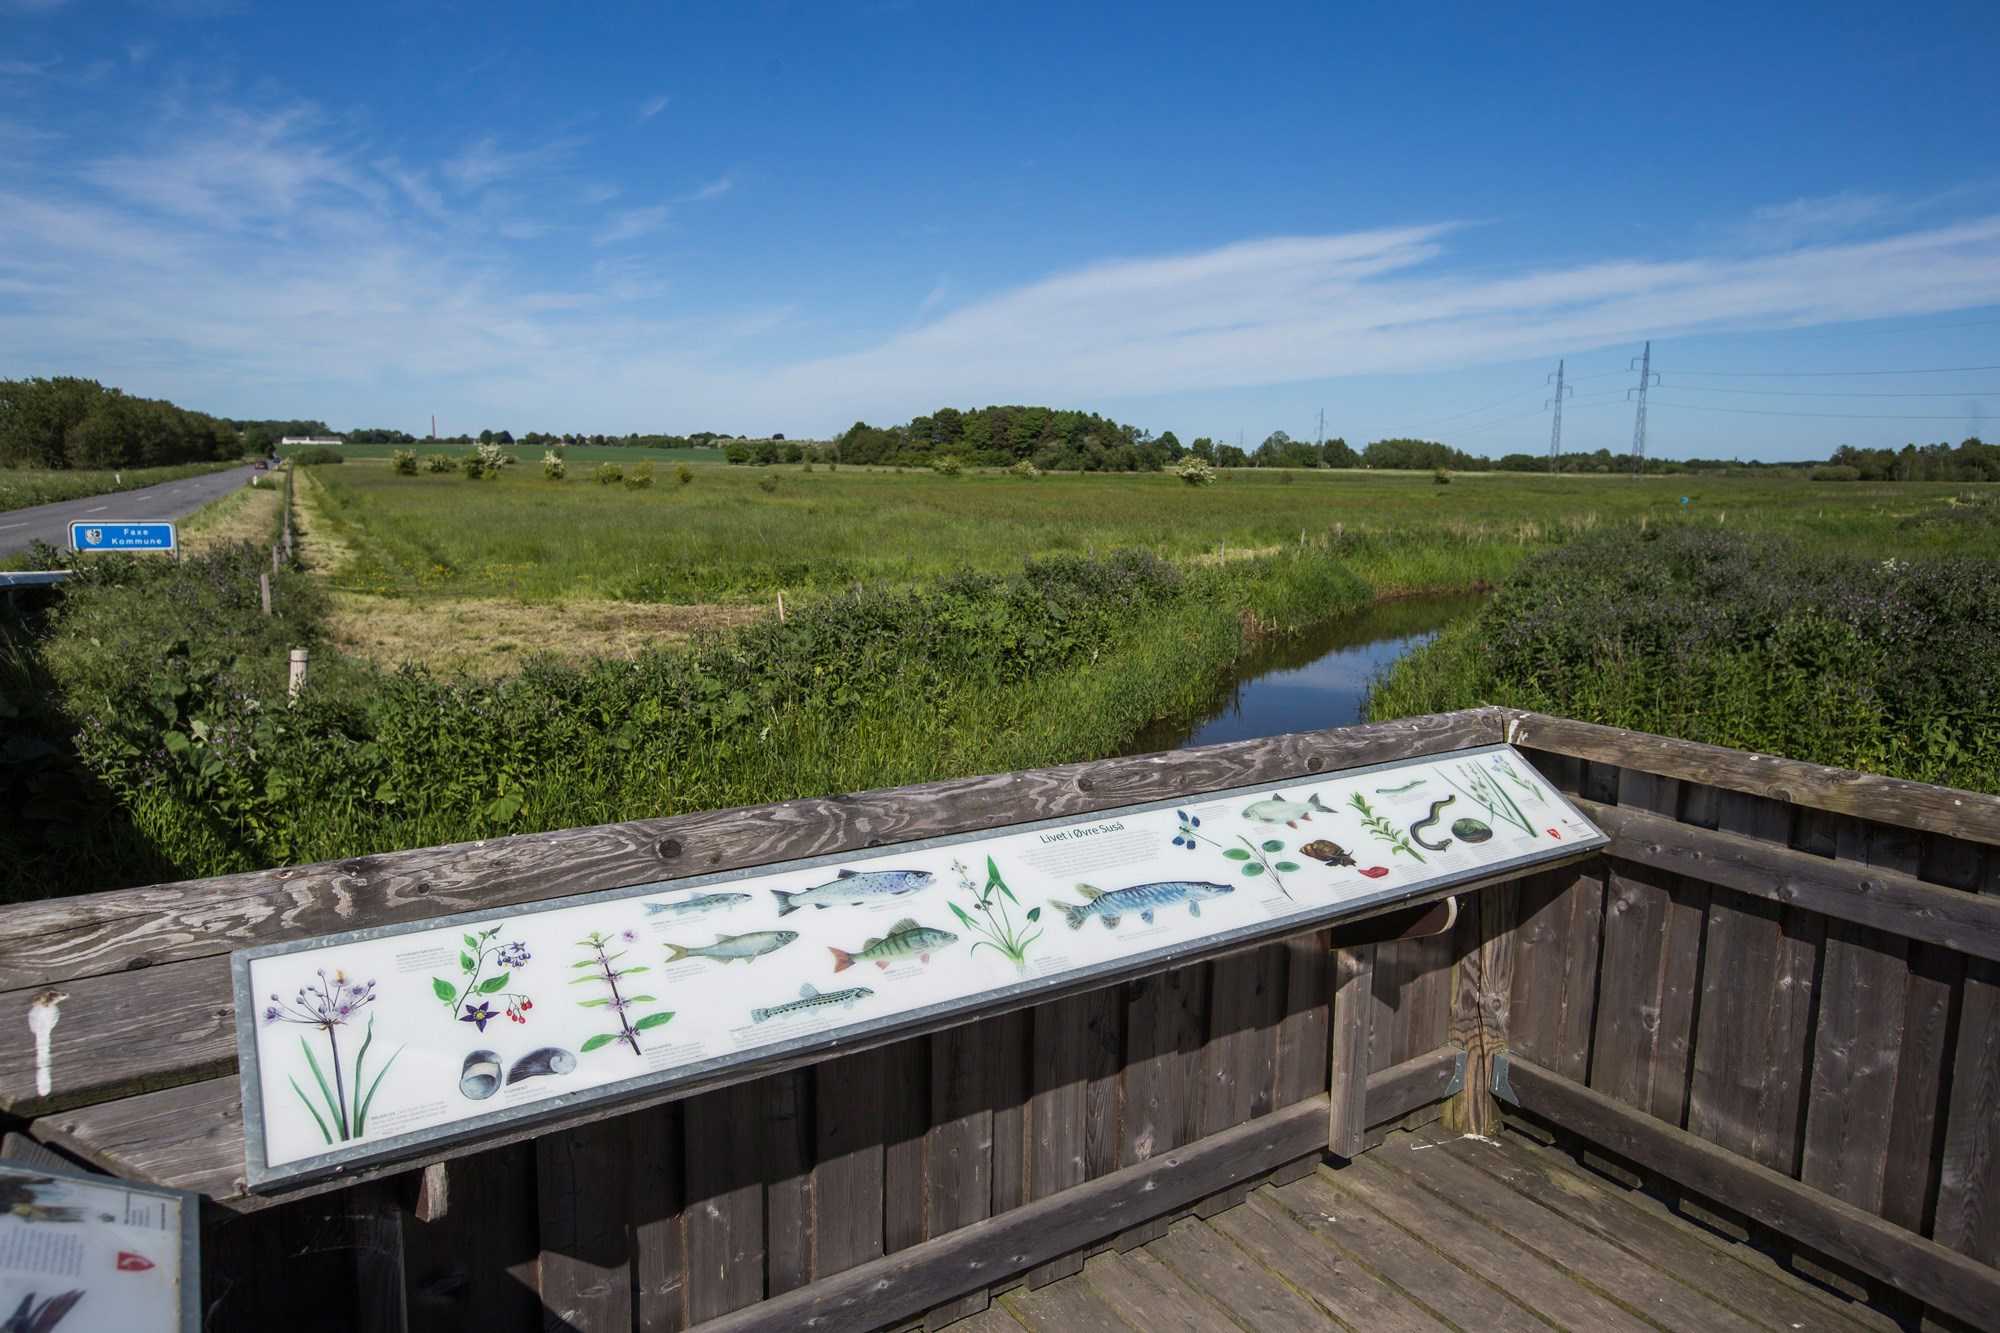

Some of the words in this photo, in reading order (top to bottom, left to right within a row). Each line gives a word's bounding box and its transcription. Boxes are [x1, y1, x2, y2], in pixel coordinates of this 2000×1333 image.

[1039, 832, 1068, 844] Livet
[1073, 828, 1099, 839] Øvre
[1099, 821, 1125, 834] Suså
